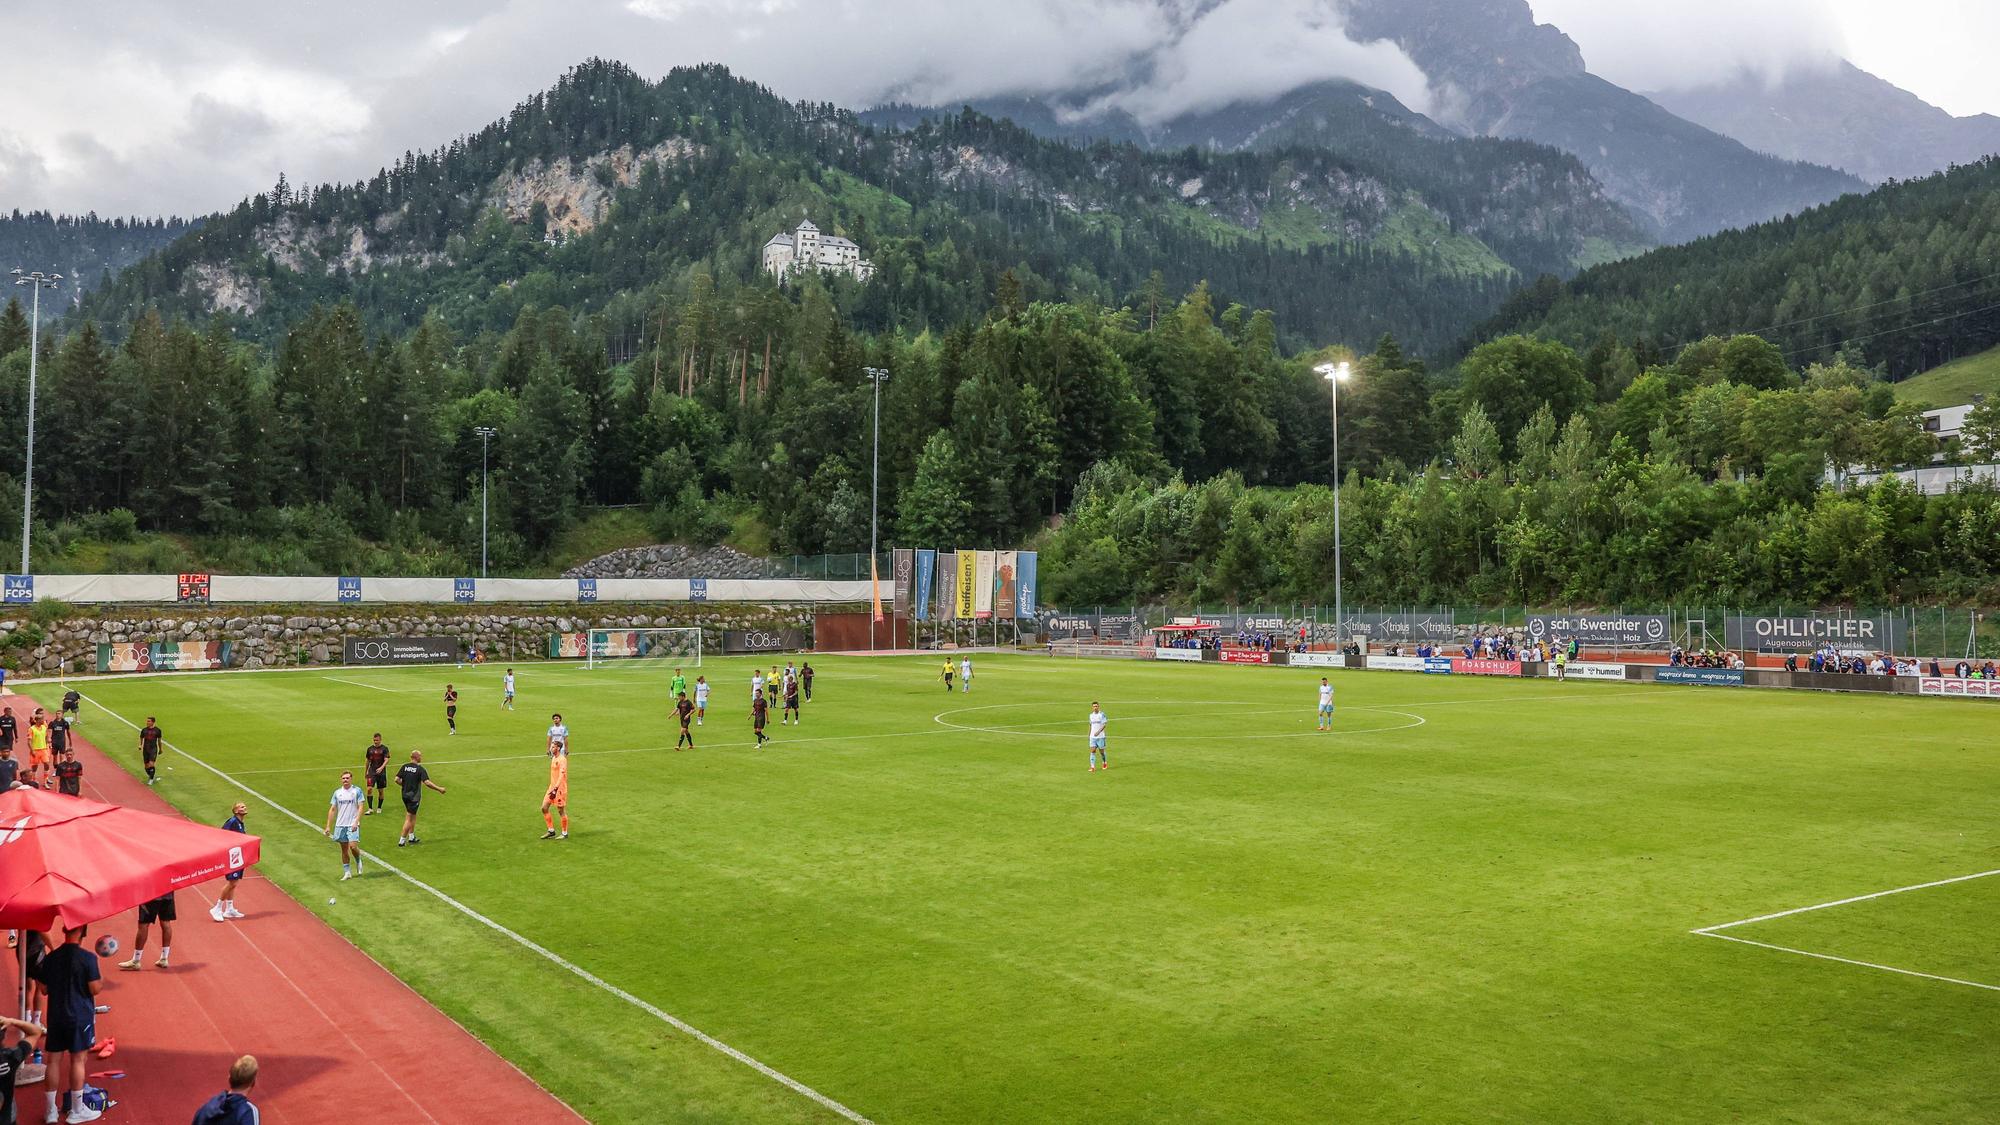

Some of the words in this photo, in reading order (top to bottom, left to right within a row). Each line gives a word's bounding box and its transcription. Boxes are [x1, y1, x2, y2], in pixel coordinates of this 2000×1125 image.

[5, 589, 33, 598] FCPS
[182, 587, 190, 598] 2
[201, 587, 209, 598] 4
[339, 589, 361, 598] FCPS
[455, 590, 475, 598] FCPS
[579, 590, 596, 598] FCPS
[690, 590, 707, 598] FCPS
[962, 563, 972, 616] Raiffeisen
[1058, 619, 1092, 630] MIESL
[1255, 618, 1283, 629] EDER
[1352, 621, 1371, 633] triplus
[1389, 621, 1410, 633] triplus
[1429, 621, 1451, 633] triplus
[1550, 617, 1641, 632] schoßwendter
[1755, 618, 1875, 638] OHLICHER
[1623, 634, 1641, 642] Holz
[1766, 639, 1812, 649] Augenoptik
[355, 641, 390, 660] 1508
[1595, 668, 1622, 676] hummel
